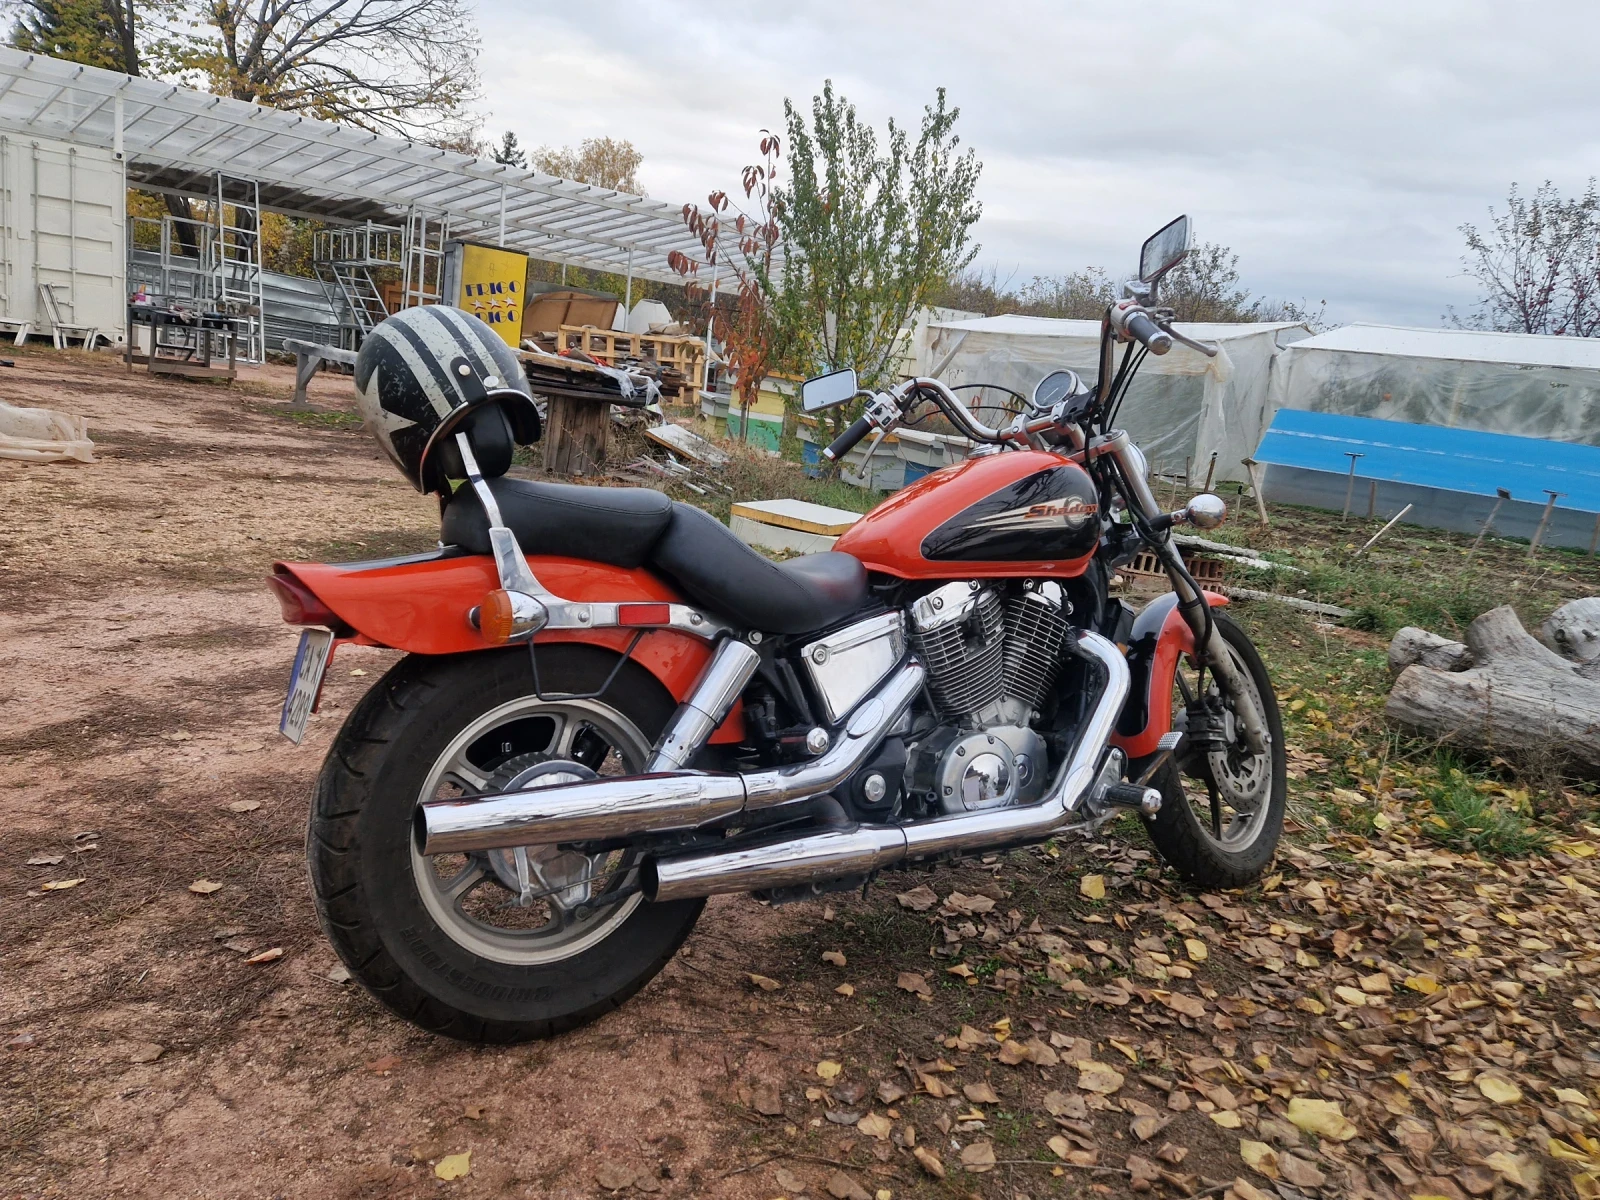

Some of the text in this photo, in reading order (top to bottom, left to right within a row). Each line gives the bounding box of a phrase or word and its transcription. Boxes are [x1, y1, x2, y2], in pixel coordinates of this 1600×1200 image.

[465, 280, 522, 297] FRIGO
[474, 309, 521, 324] RIGO
[1023, 503, 1099, 520] Shadow
